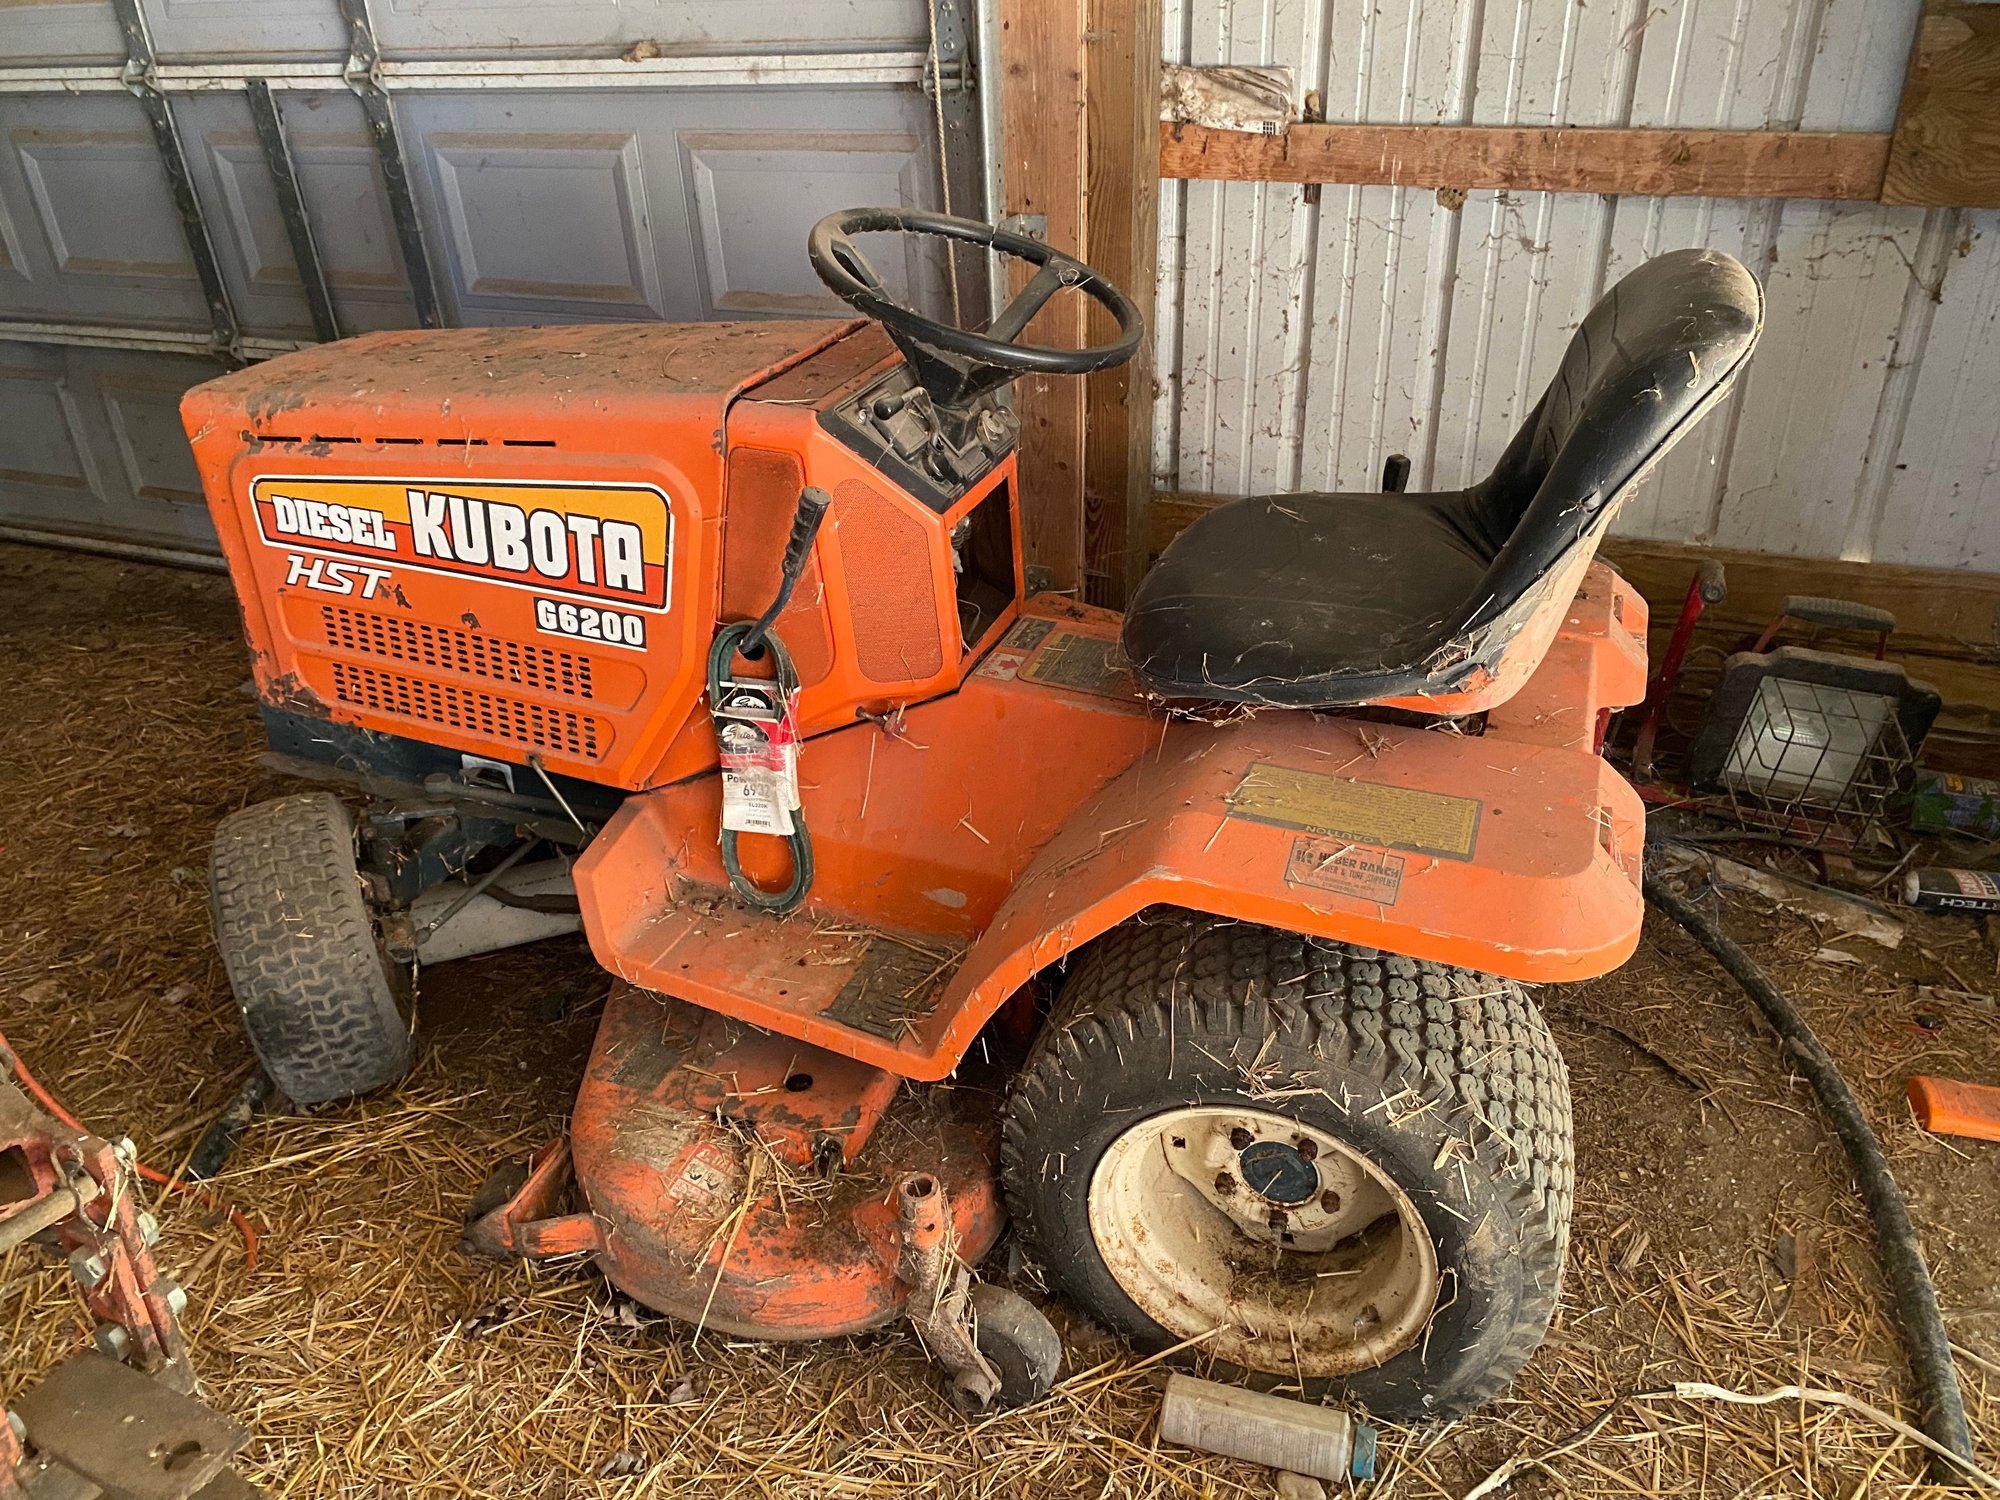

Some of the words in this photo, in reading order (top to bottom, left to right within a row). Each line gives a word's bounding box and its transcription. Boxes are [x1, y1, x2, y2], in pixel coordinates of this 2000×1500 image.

[271, 494, 398, 552] DIESEL
[406, 488, 647, 595] KUBOTA
[284, 554, 393, 599] HST
[537, 600, 644, 646] G6200
[1305, 825, 1375, 843] CAUTION
[1316, 862, 1339, 874] PWER
[1318, 851, 1357, 869] HBER
[1359, 861, 1401, 878] RANCH
